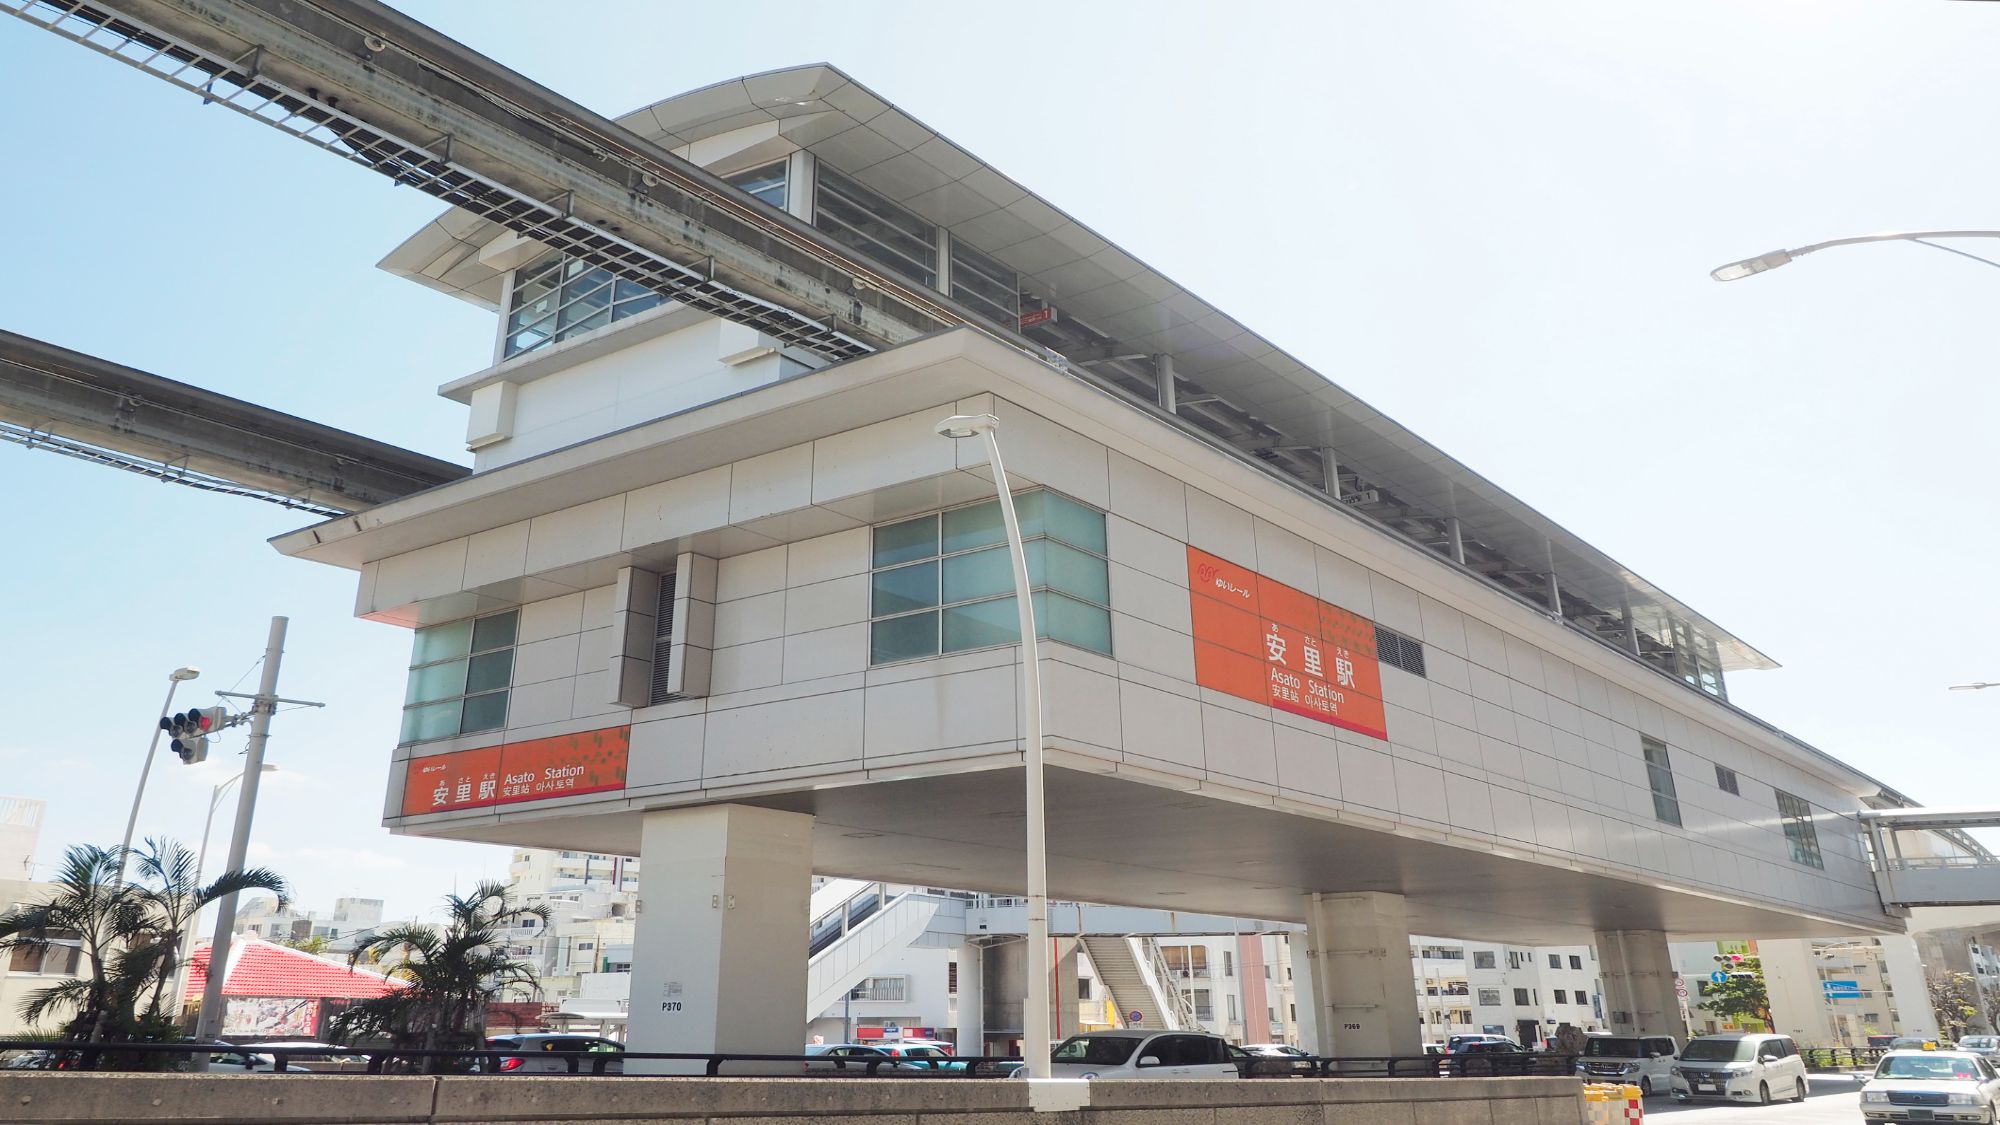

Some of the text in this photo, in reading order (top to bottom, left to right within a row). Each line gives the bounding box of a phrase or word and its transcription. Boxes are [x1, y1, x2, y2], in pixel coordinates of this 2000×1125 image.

[1215, 577, 1250, 598] ゆいレール
[1271, 623, 1349, 659] あ さと えき
[1271, 667, 1344, 704] Asato Station
[1272, 683, 1299, 703] 安里站
[1305, 695, 1338, 715] 아사토역
[504, 764, 584, 785] Asato Station
[503, 785, 529, 797] 安里站
[536, 778, 574, 792] 아사토역
[662, 1001, 682, 1012] P370
